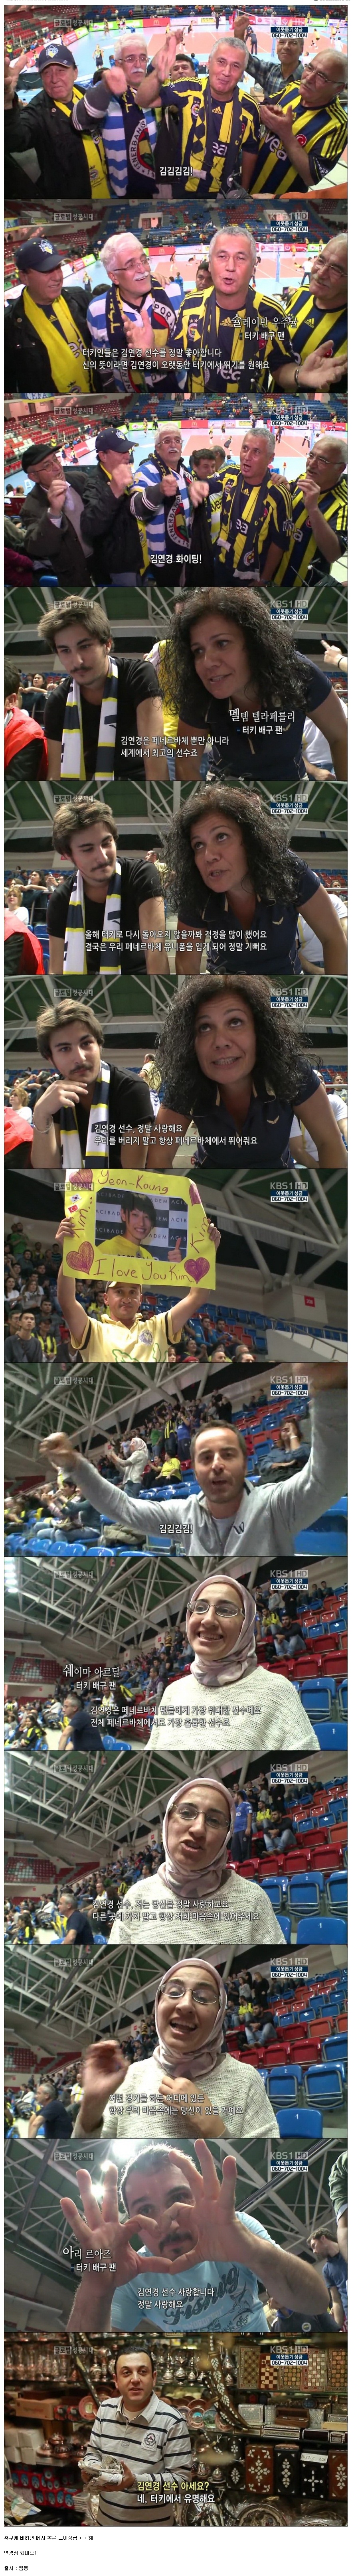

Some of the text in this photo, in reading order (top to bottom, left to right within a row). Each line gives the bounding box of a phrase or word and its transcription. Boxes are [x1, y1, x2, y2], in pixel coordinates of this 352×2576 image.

[93, 1259, 107, 1275] I
[112, 1259, 138, 1278] love
[142, 1262, 166, 1280] You
